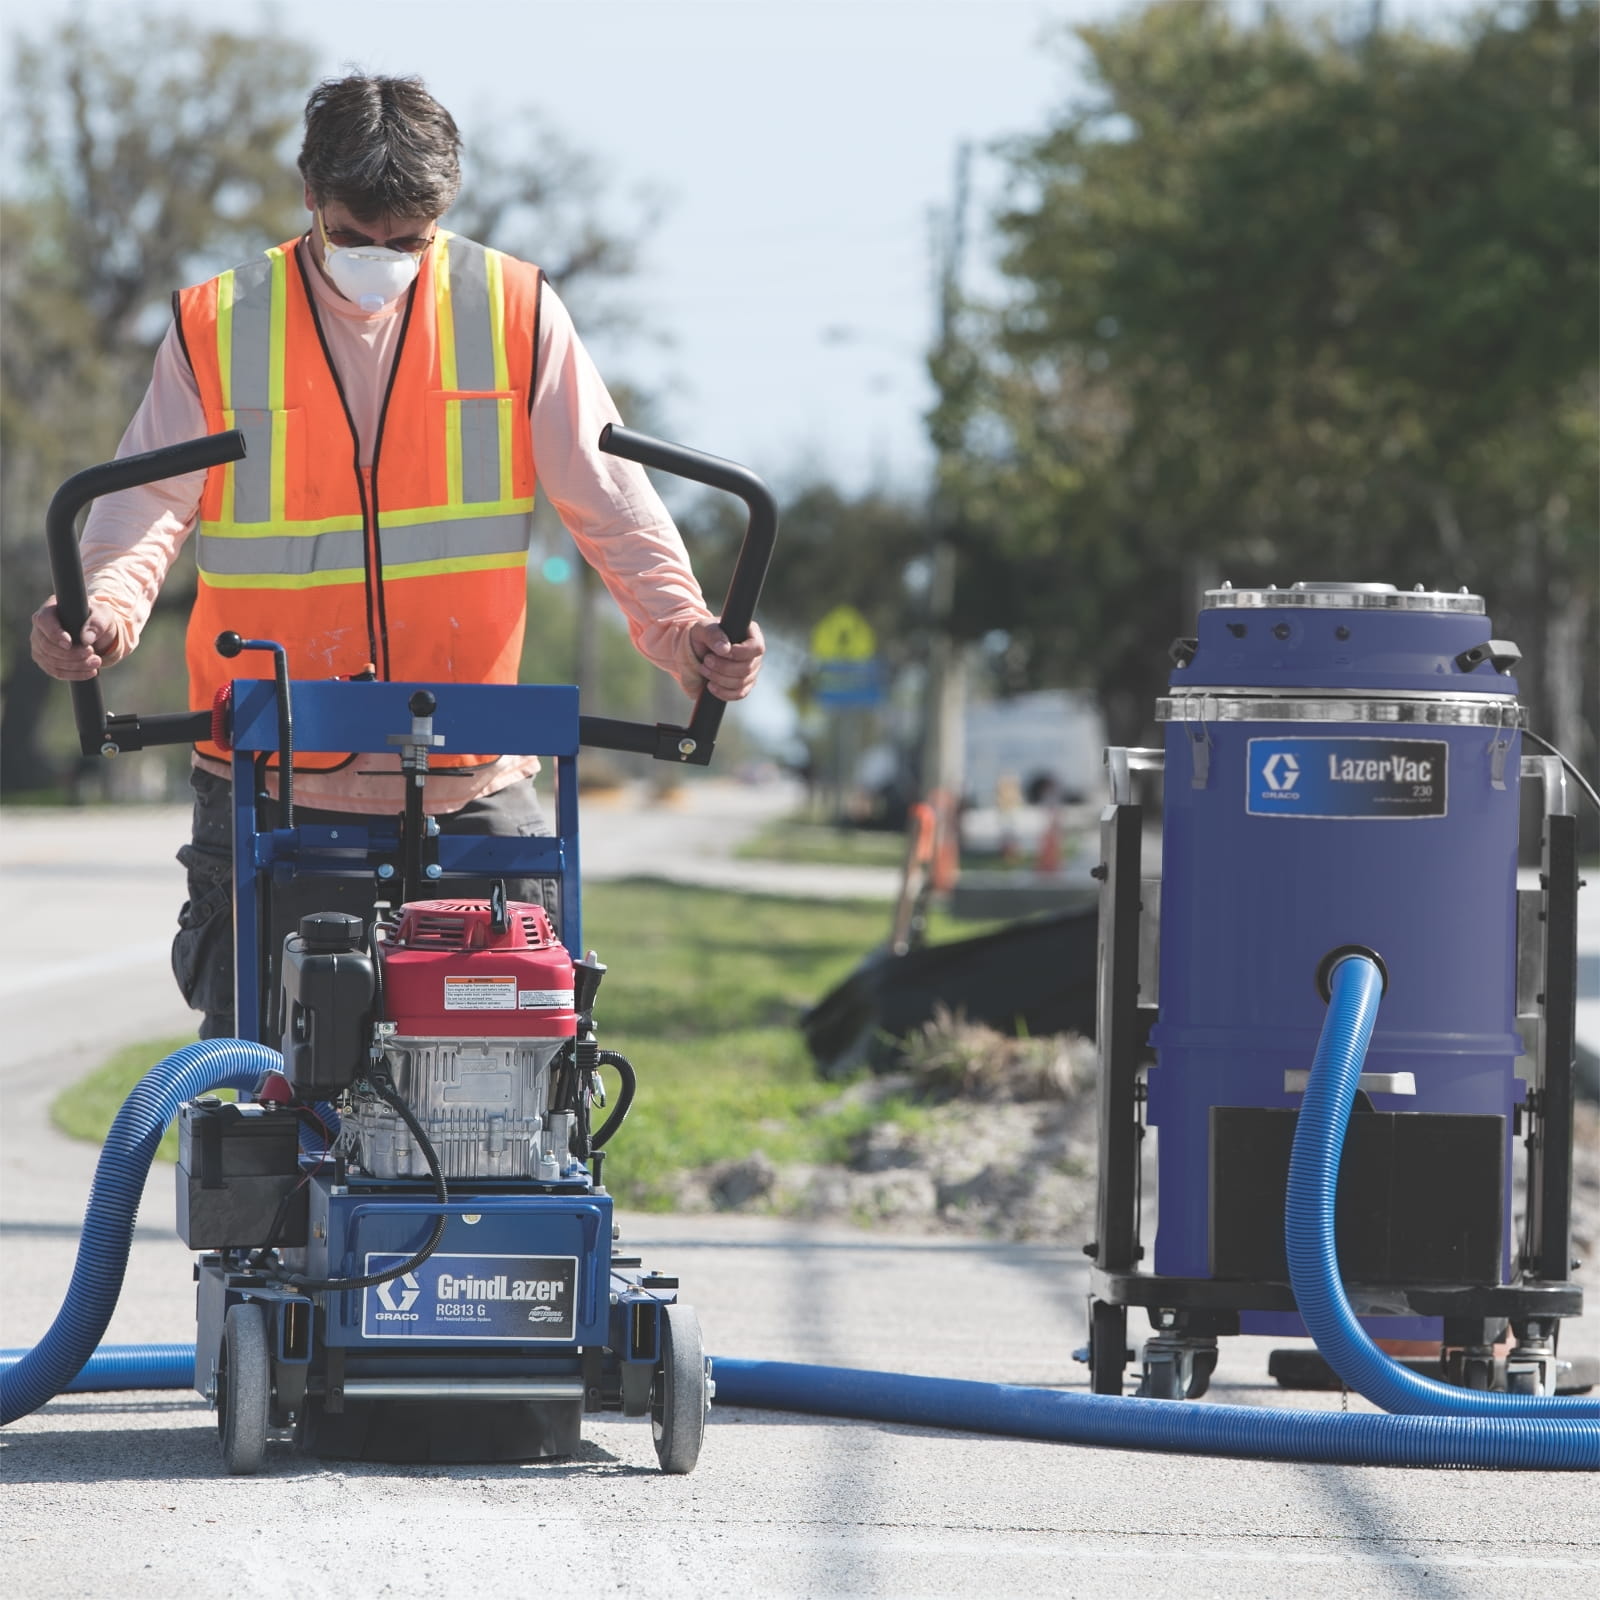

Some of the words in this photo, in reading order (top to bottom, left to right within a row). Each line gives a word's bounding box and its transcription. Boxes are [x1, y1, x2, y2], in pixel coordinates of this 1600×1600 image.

[1328, 753, 1433, 783] LazerVac
[1261, 791, 1300, 800] GRACO
[1412, 785, 1433, 797] 230
[437, 1274, 564, 1301] GrindLazer
[375, 1312, 419, 1321] GRACO
[436, 1303, 474, 1316] RC813
[477, 1304, 486, 1317] G
